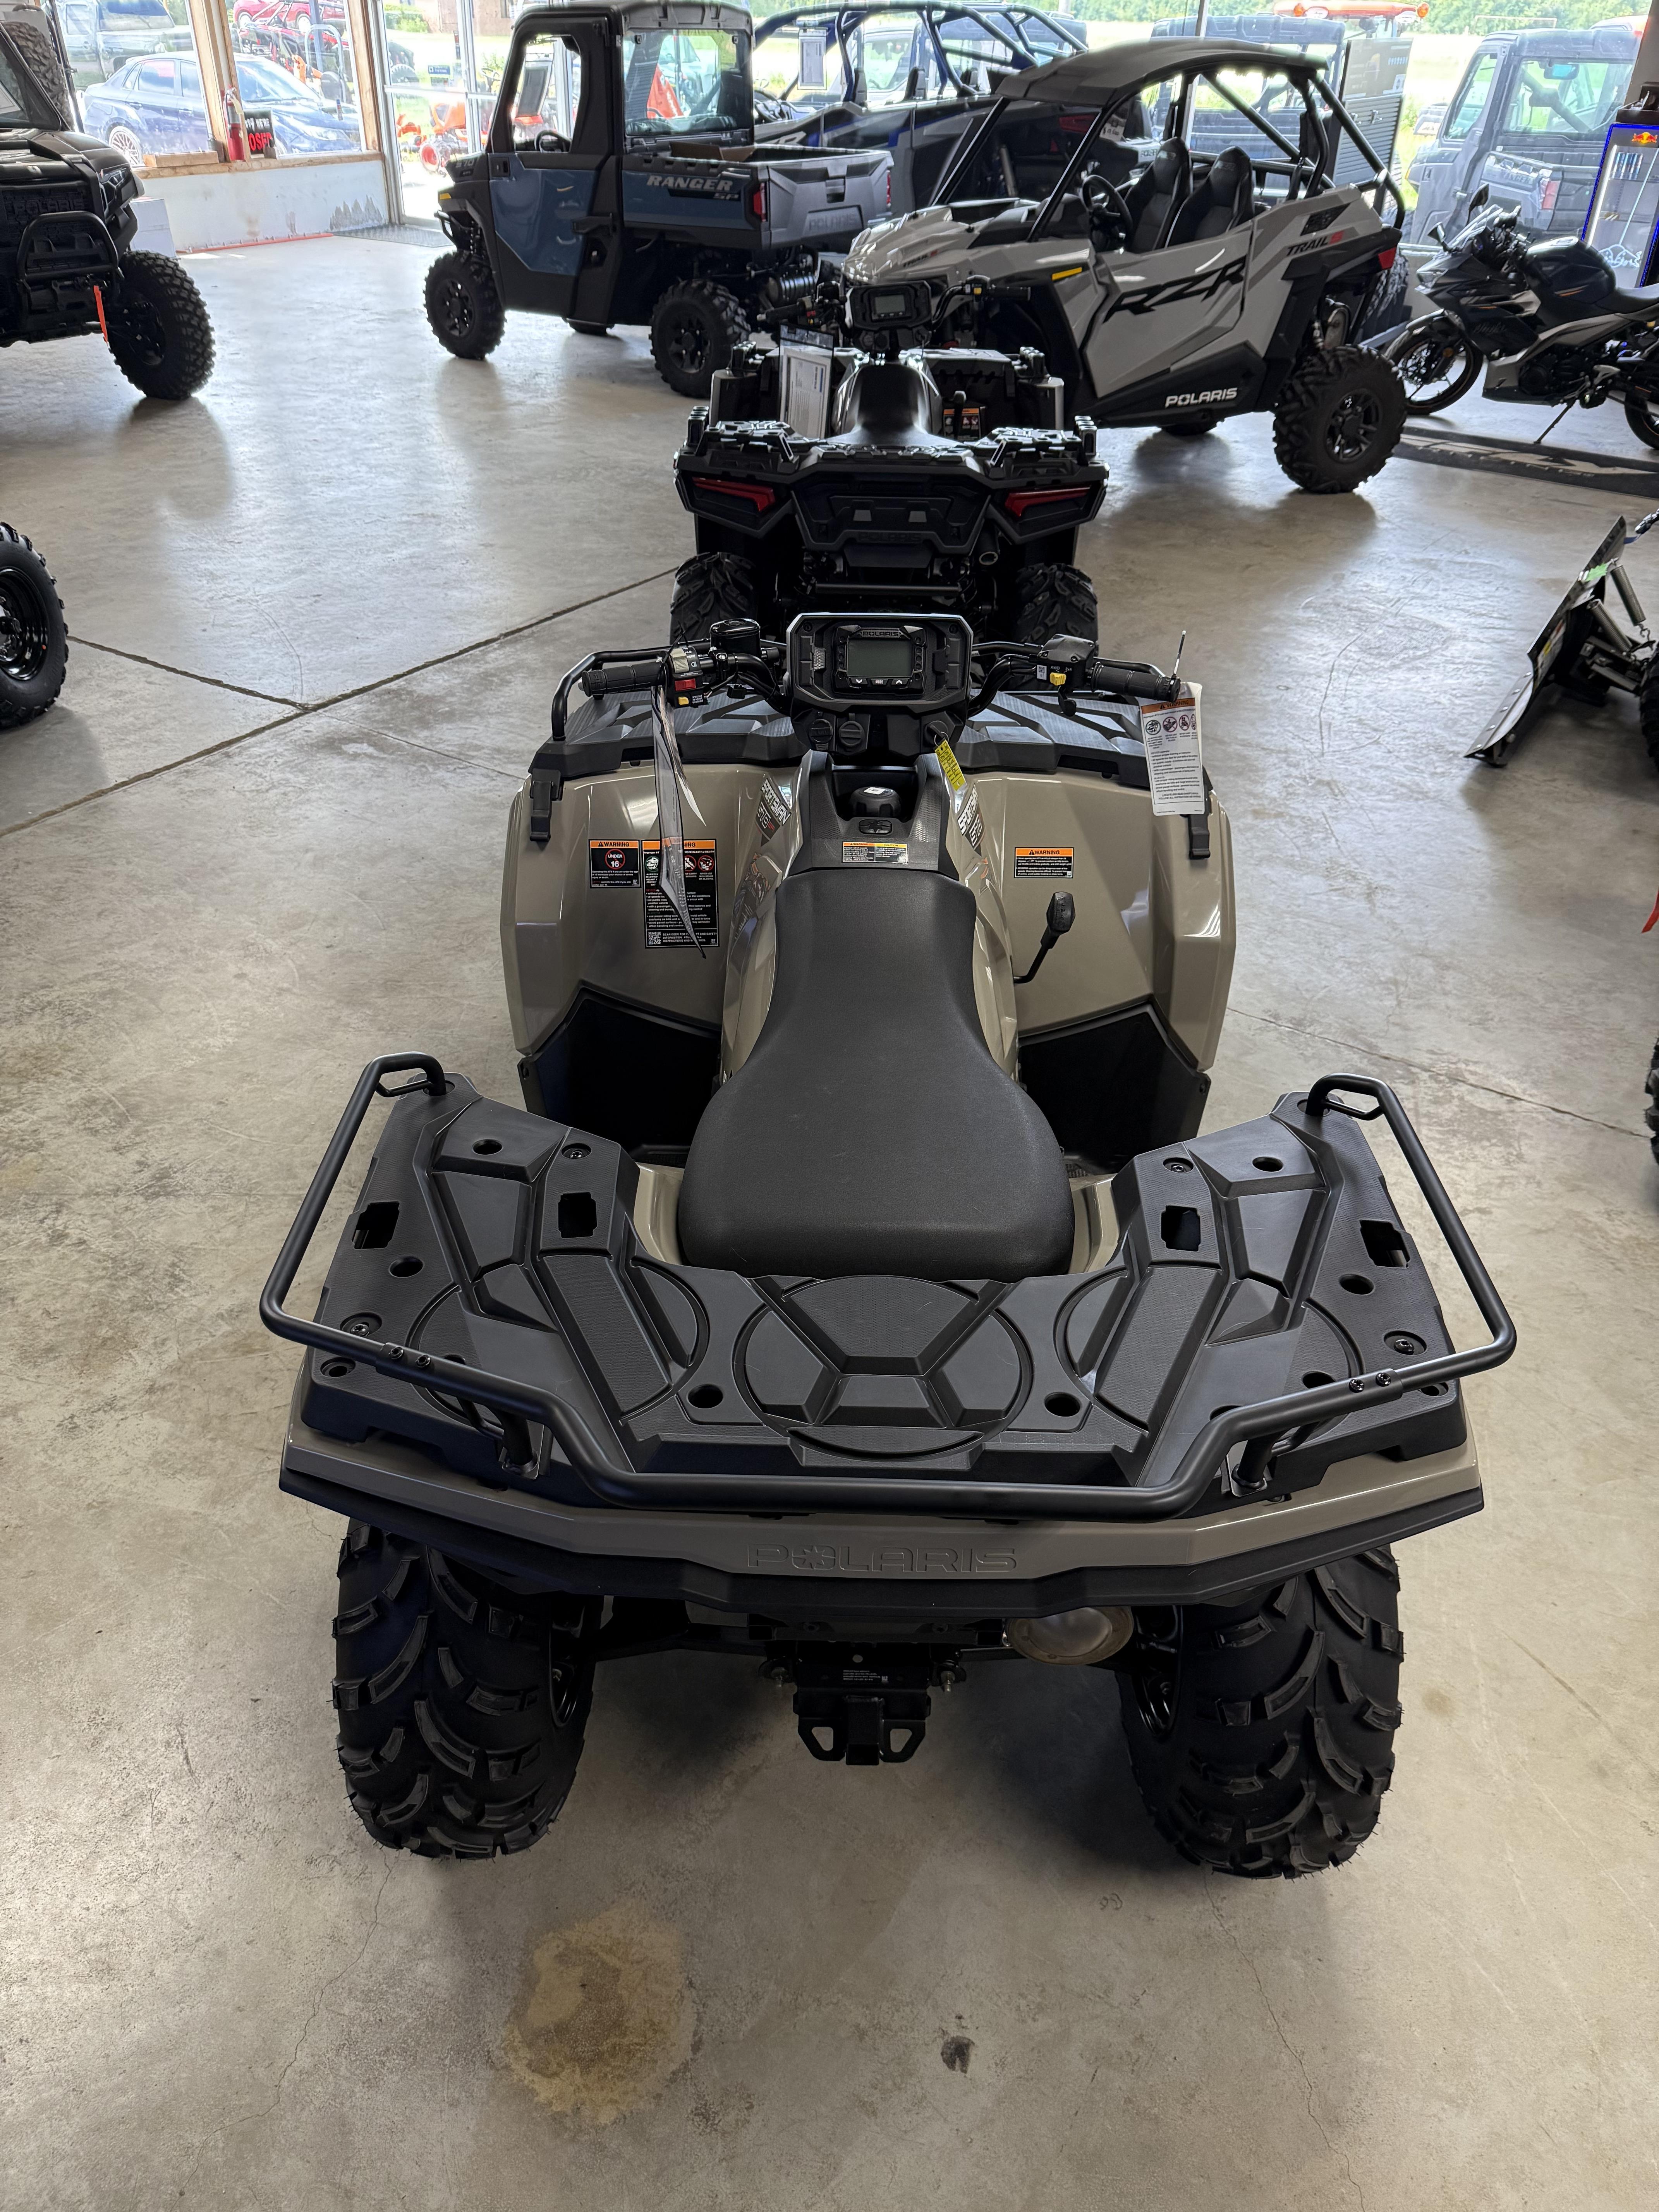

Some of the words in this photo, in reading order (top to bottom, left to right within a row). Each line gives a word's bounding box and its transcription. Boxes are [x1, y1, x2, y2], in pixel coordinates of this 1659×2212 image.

[647, 175, 733, 191] RANGER
[1286, 236, 1328, 256] TRAIL
[1164, 387, 1238, 408] POLARIS
[761, 778, 791, 825] SPORTSMAN
[748, 1543, 1017, 1573] POLARIS
